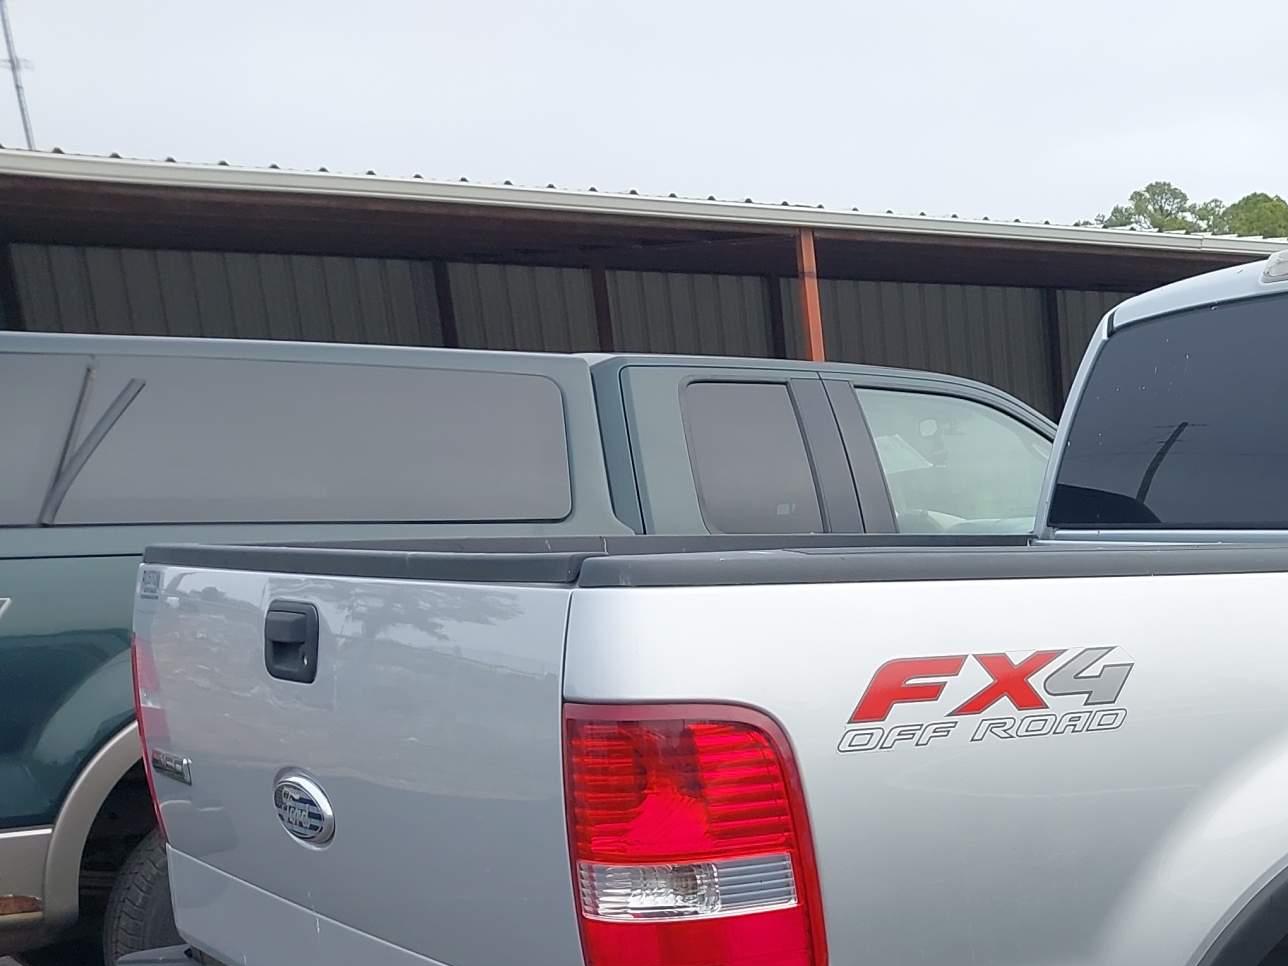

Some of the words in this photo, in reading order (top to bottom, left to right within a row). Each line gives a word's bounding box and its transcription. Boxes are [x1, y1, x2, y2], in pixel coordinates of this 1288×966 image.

[847, 646, 1135, 724] FX4
[837, 721, 959, 753] OFF
[970, 708, 1128, 742] ROAD
